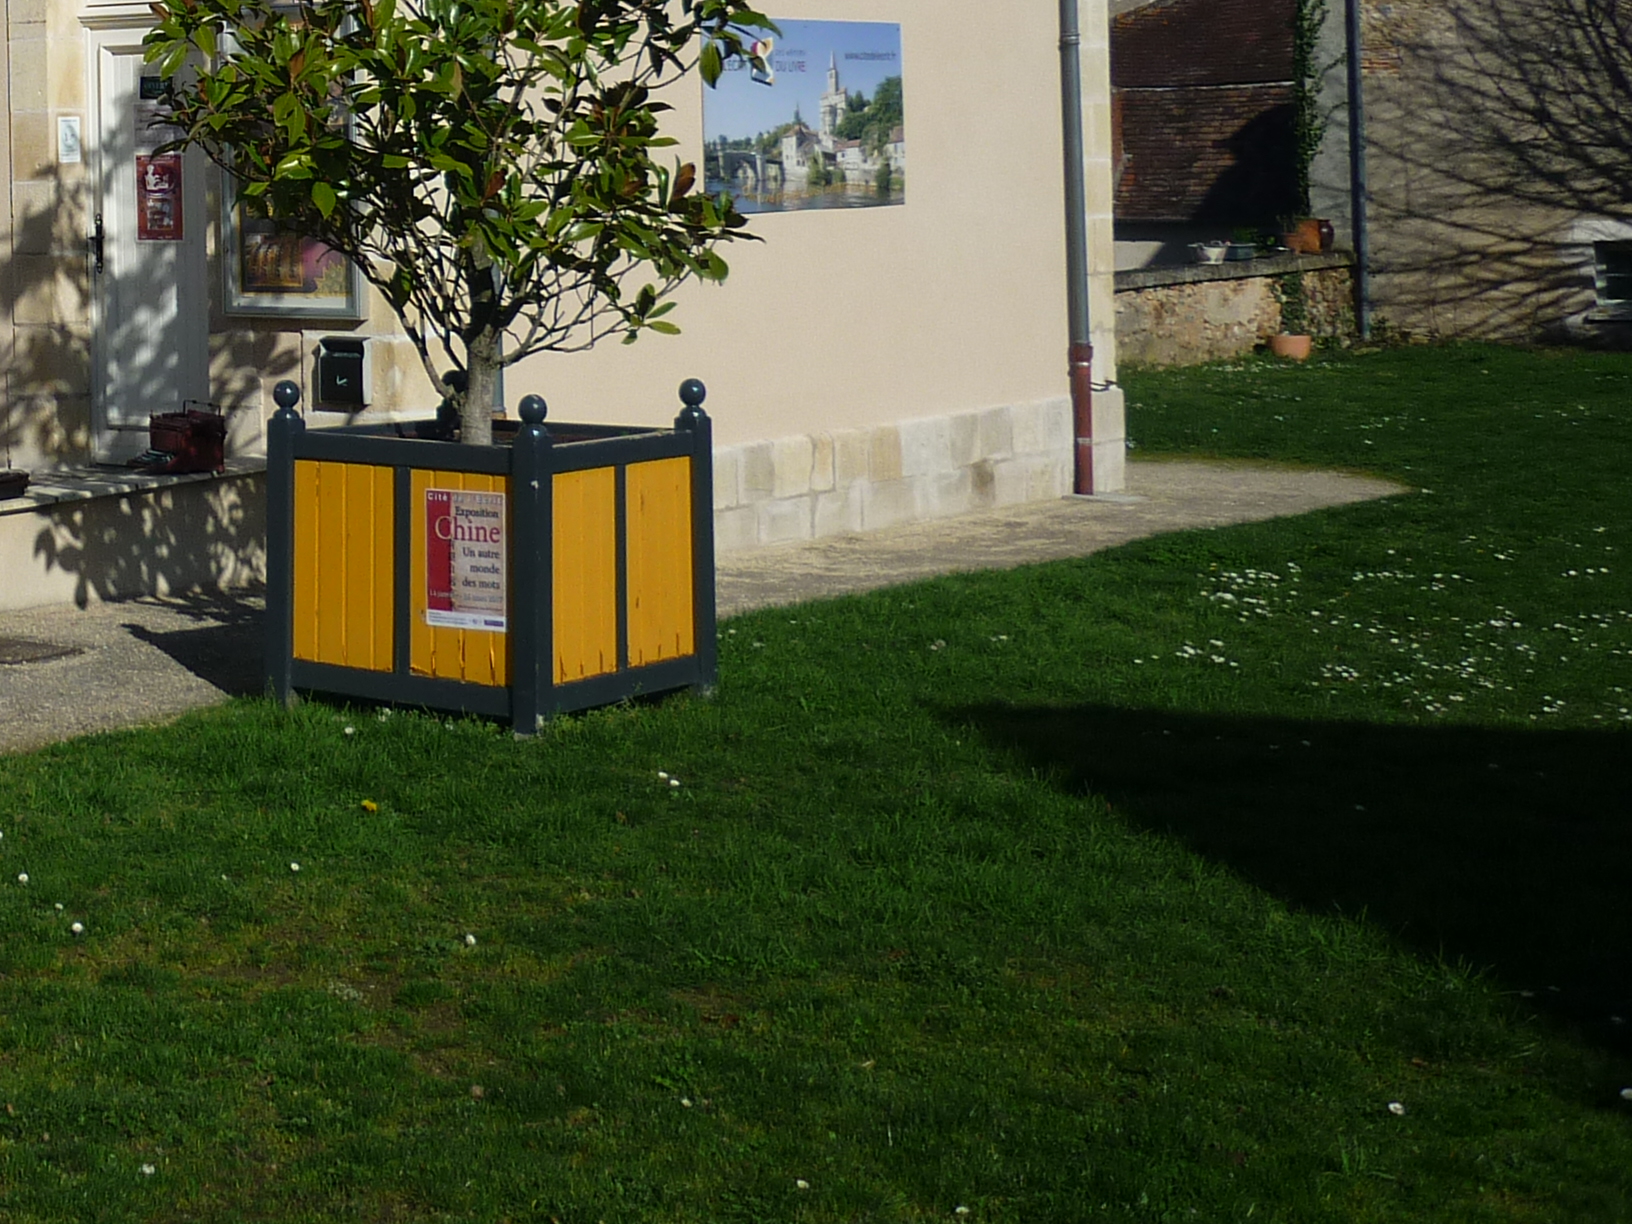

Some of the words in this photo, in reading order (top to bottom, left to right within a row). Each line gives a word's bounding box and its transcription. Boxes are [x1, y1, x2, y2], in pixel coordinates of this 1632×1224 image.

[427, 492, 448, 502] Cité
[455, 506, 499, 519] Exposition
[435, 515, 500, 544] Chine
[462, 546, 476, 557] Un
[478, 549, 500, 559] autre
[470, 563, 500, 574] monde
[462, 577, 476, 587] des
[479, 580, 500, 589] mots
